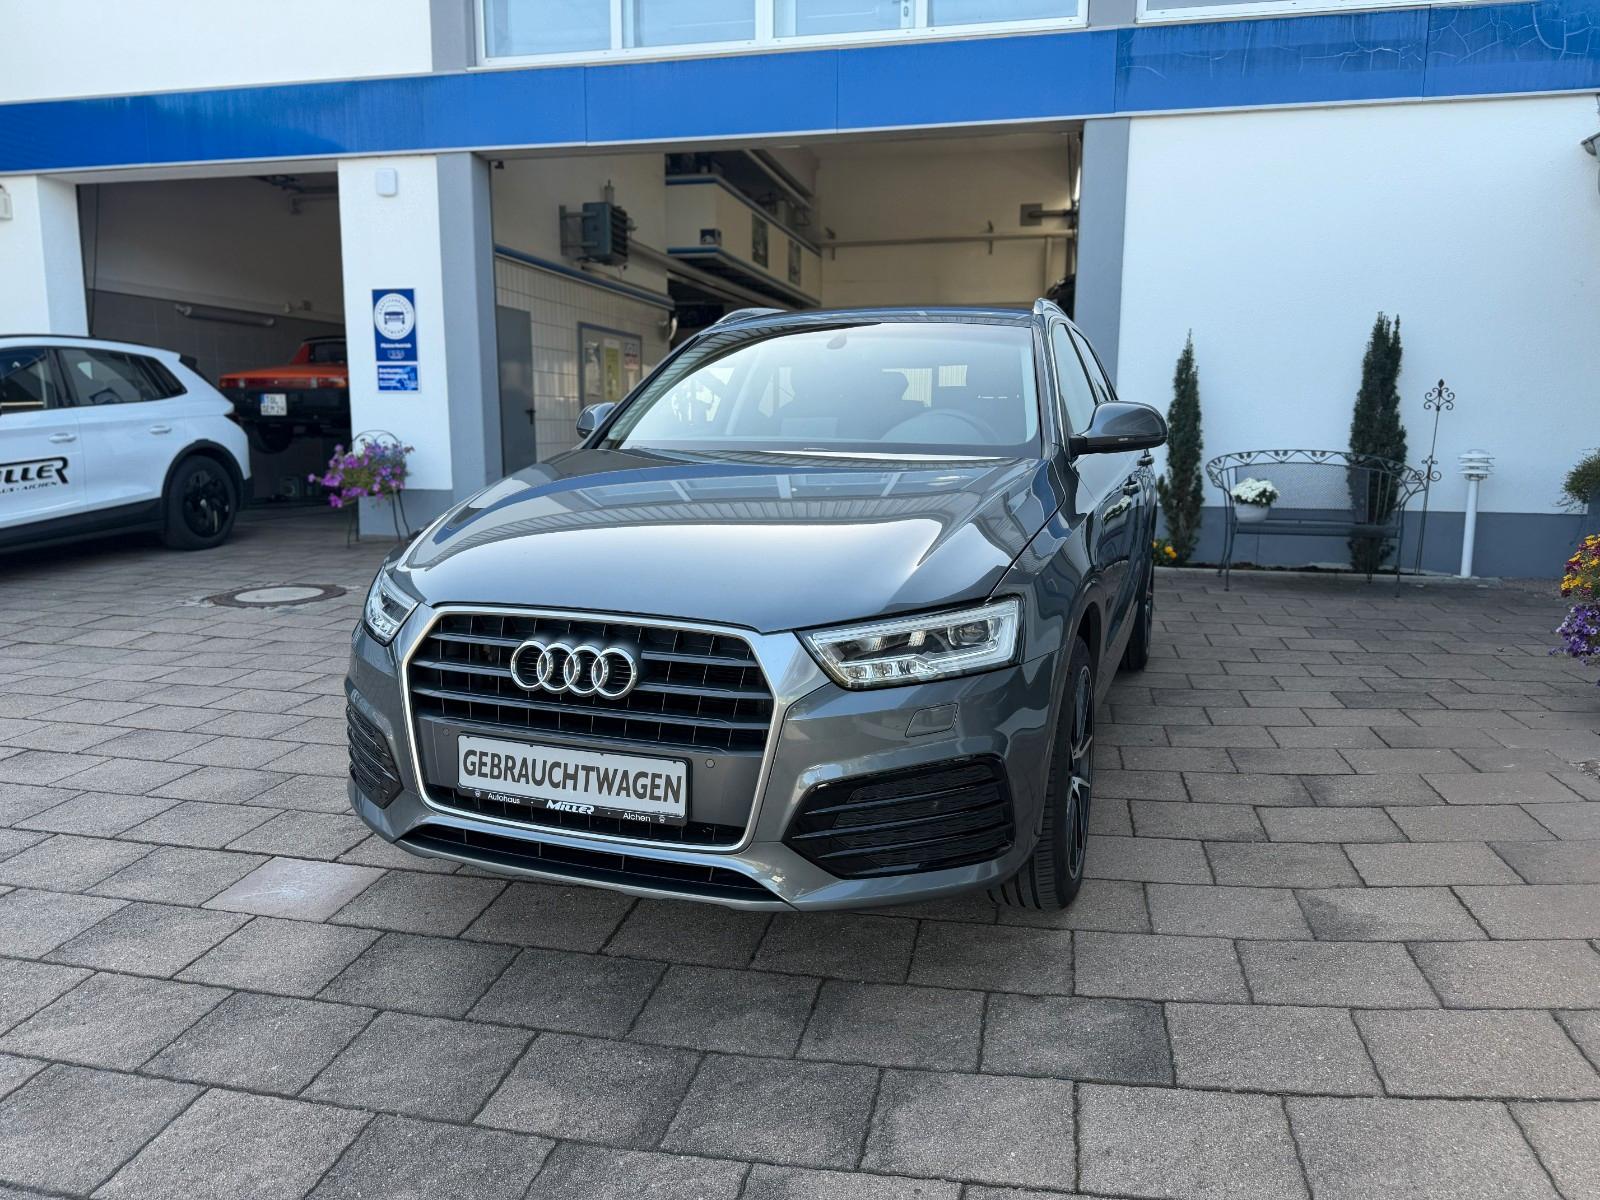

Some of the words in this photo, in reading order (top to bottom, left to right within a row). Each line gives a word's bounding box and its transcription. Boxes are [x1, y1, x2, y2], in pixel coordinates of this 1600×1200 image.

[463, 749, 682, 803] GEBRAUCHTWAGEN
[488, 793, 521, 805] Autohaus
[623, 812, 651, 823] Aichen
